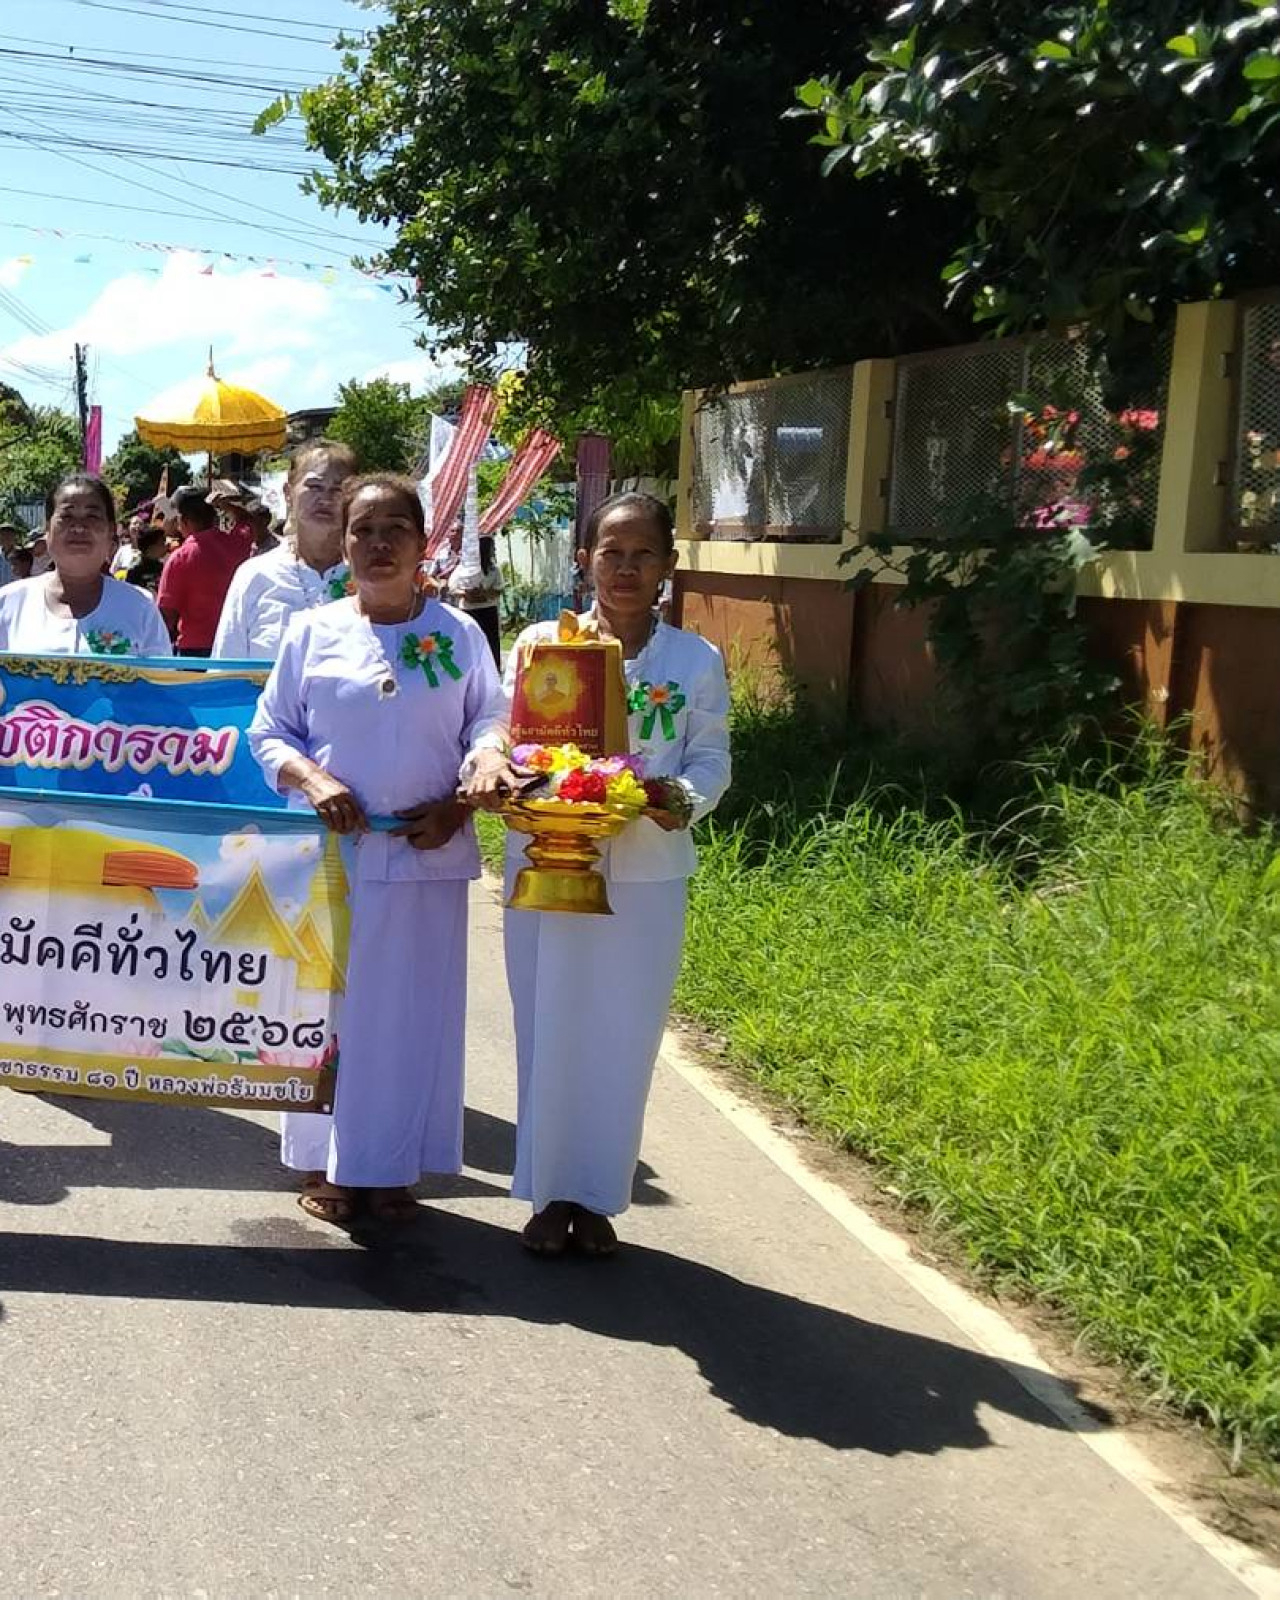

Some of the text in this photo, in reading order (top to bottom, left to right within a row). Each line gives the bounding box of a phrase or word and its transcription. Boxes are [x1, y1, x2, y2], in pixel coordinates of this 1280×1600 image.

[3, 999, 168, 1037] พุทธศักราช
[184, 1010, 325, 1049] ๒๕๖๘
[87, 1071, 116, 1087] ๘๑
[125, 1067, 139, 1089] ปี
[148, 1074, 313, 1101] หลวงพ่อธัมมชโย
